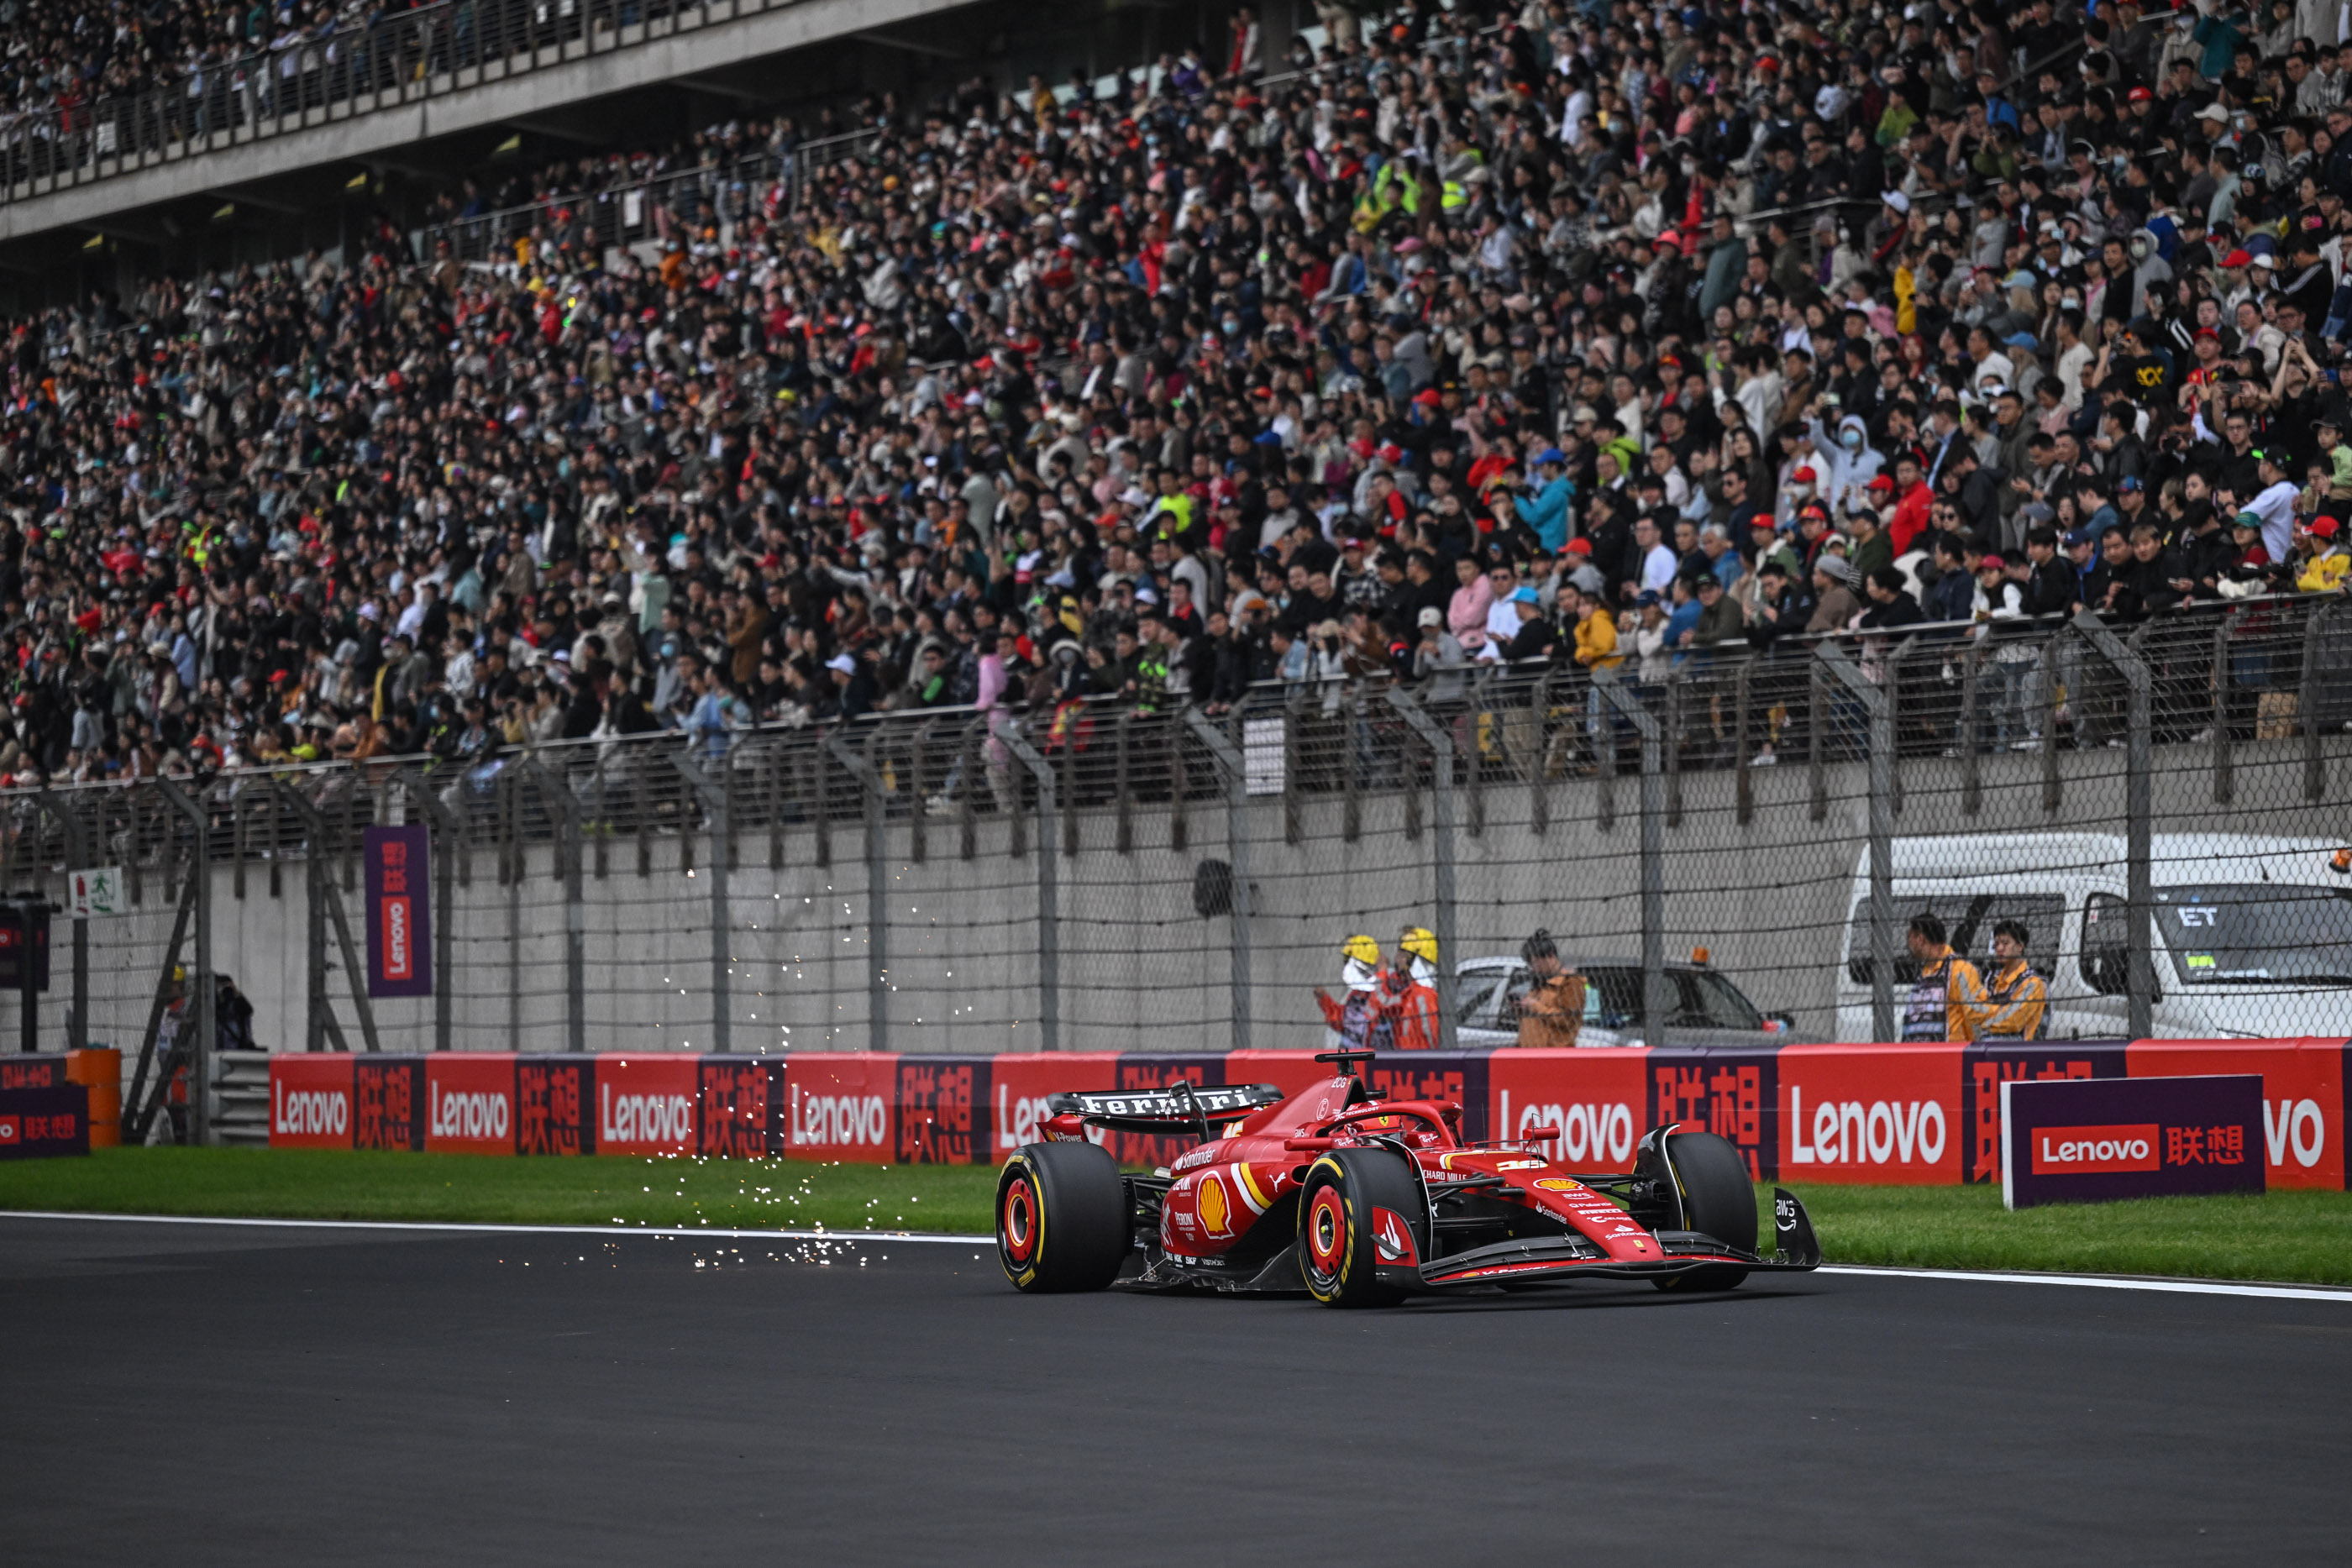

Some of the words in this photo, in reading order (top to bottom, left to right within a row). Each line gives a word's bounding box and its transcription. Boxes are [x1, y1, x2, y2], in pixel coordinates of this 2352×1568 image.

[389, 902, 406, 974] Lenovo
[276, 1079, 347, 1135] Lenovo
[358, 1066, 411, 1151] 联想
[432, 1080, 508, 1138] Lenovo
[519, 1067, 580, 1155] 联想
[602, 1083, 690, 1142] Lenovo
[702, 1066, 768, 1159] 联想
[791, 1083, 886, 1146] Lenovo
[900, 1066, 974, 1164] 联想
[1346, 1106, 1379, 1116] TECHNOLOGY
[1499, 1089, 1632, 1164] Lenovo
[1791, 1086, 1946, 1166] Lenovo
[1183, 1147, 1215, 1169] Santander
[1496, 1160, 1549, 1172] 16
[2042, 1137, 2150, 1162] Lenovo
[2166, 1125, 2244, 1166] 联想
[1422, 1170, 1445, 1181] CHARD
[1174, 1211, 1194, 1225] PERONI
[1542, 1205, 1567, 1225] Santander
[1776, 1199, 1796, 1218] aws
[1605, 1232, 1651, 1240] Santander
[1185, 1256, 1197, 1265] SKF
